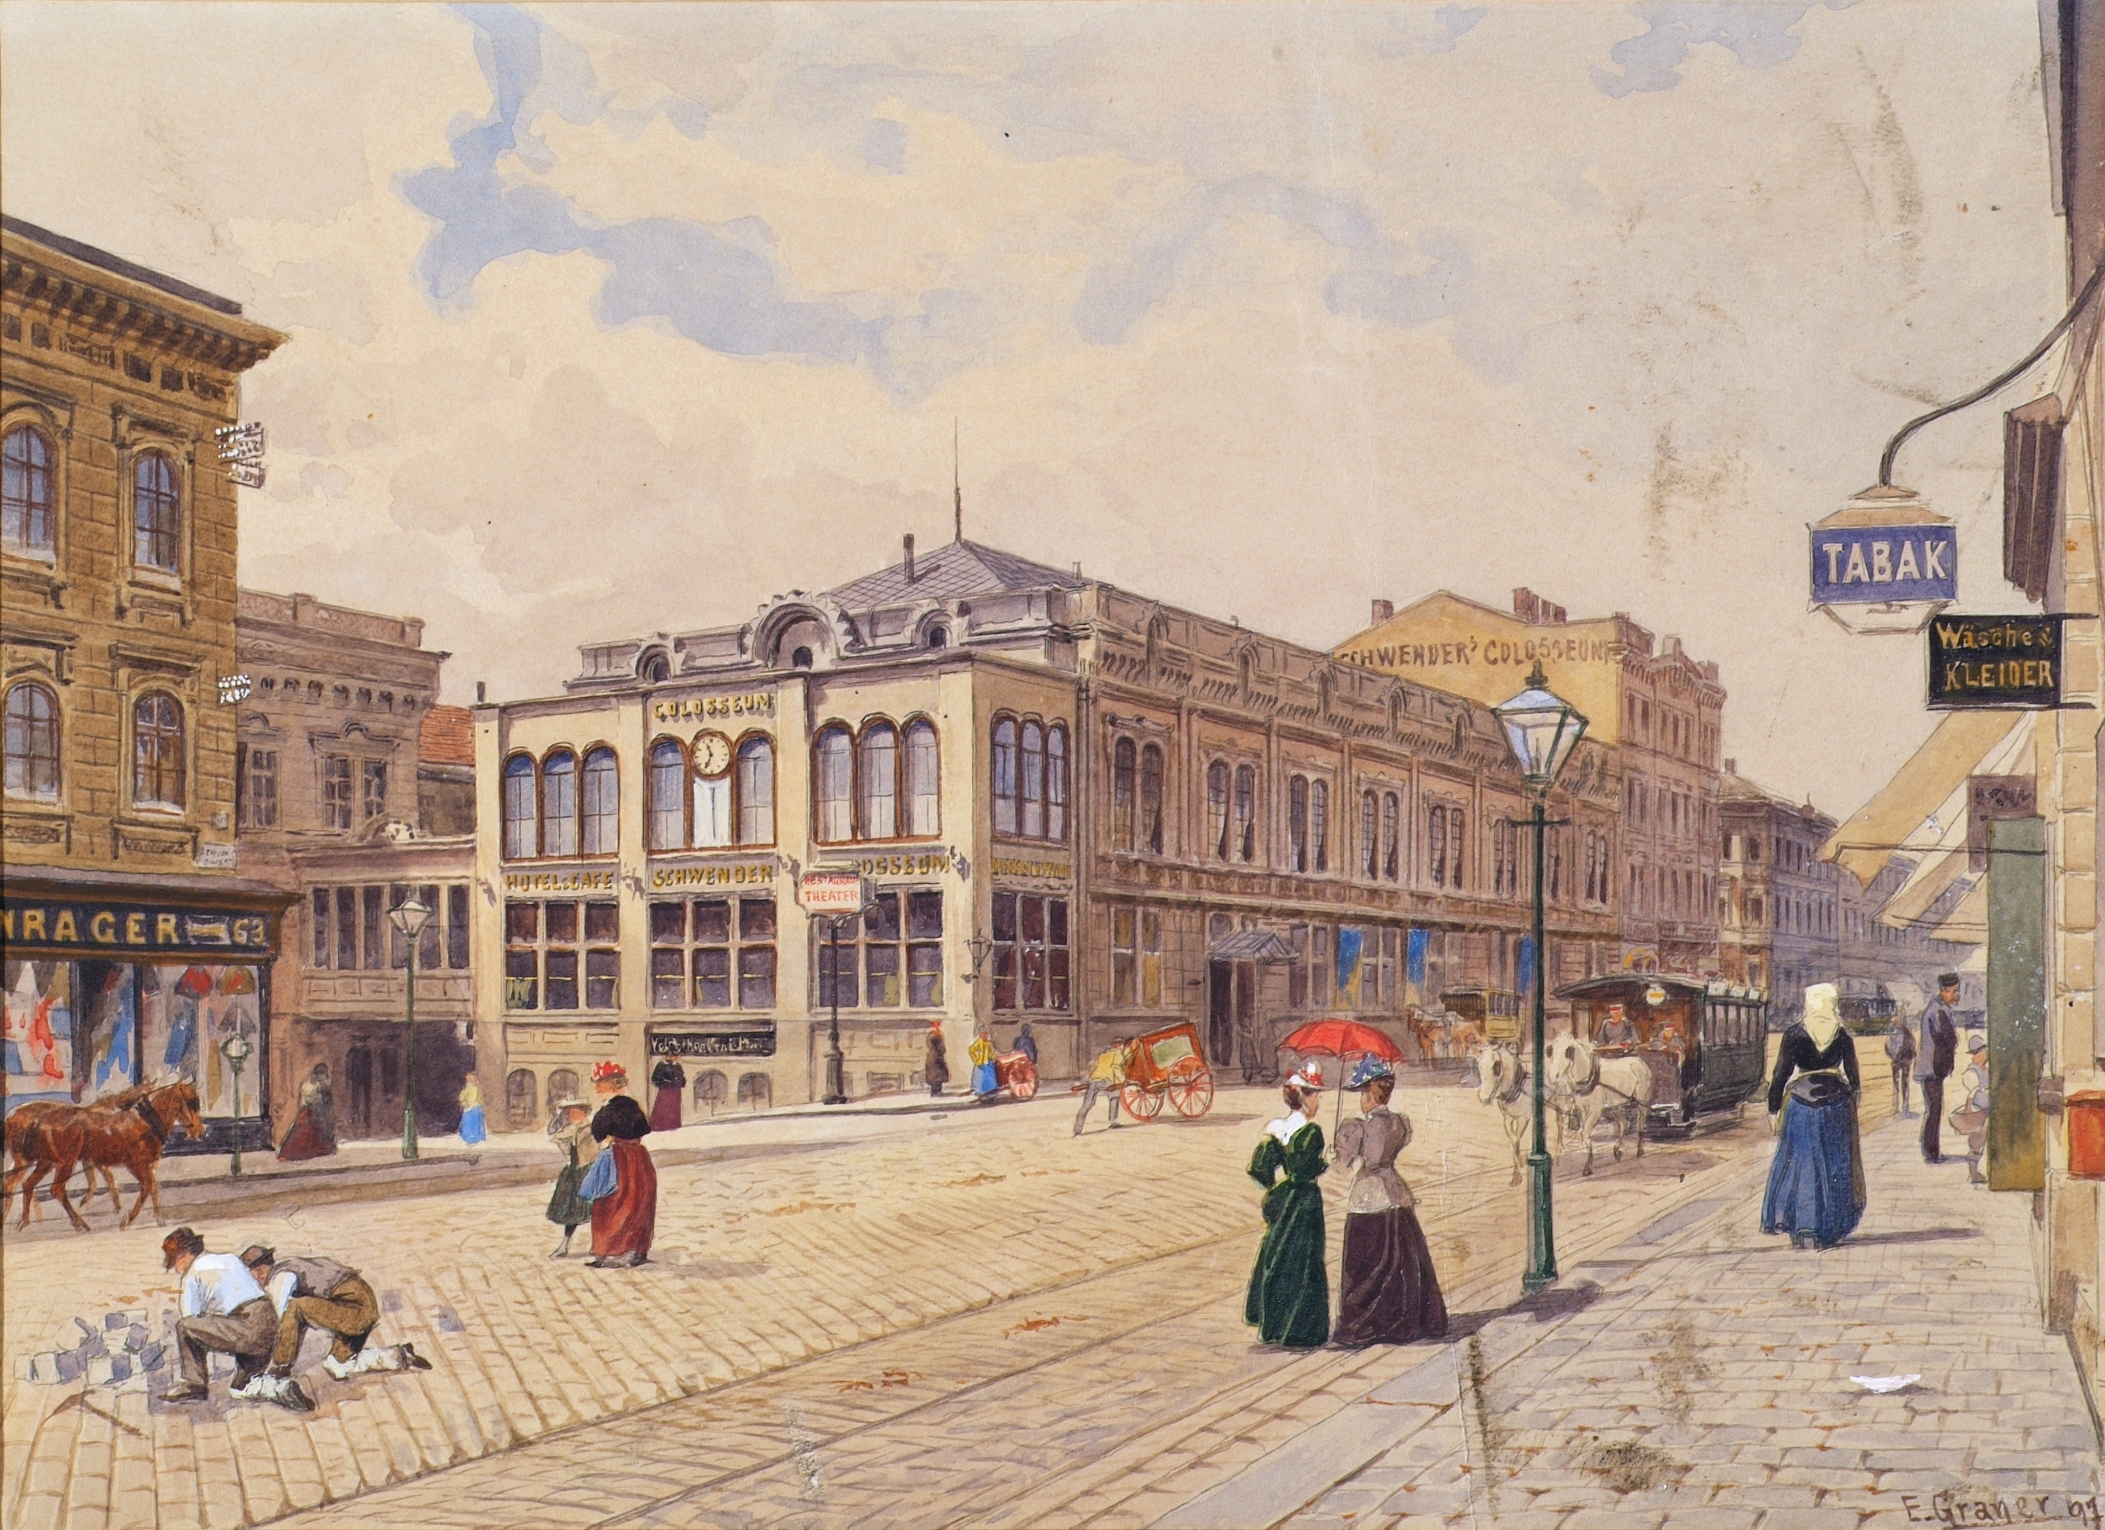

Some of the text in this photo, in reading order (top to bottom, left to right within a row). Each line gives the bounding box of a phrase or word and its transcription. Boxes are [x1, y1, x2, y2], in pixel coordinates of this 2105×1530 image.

[1822, 540, 1949, 584] TABAK
[1935, 622, 2033, 650] Wäsche
[1944, 660, 2055, 692] KLEIDER
[653, 692, 773, 720] COLOSSEUM
[652, 864, 773, 890] SCHWENDER
[862, 854, 950, 876] OSSEUM
[505, 873, 561, 892] HOTEL
[805, 890, 858, 902] THEATER
